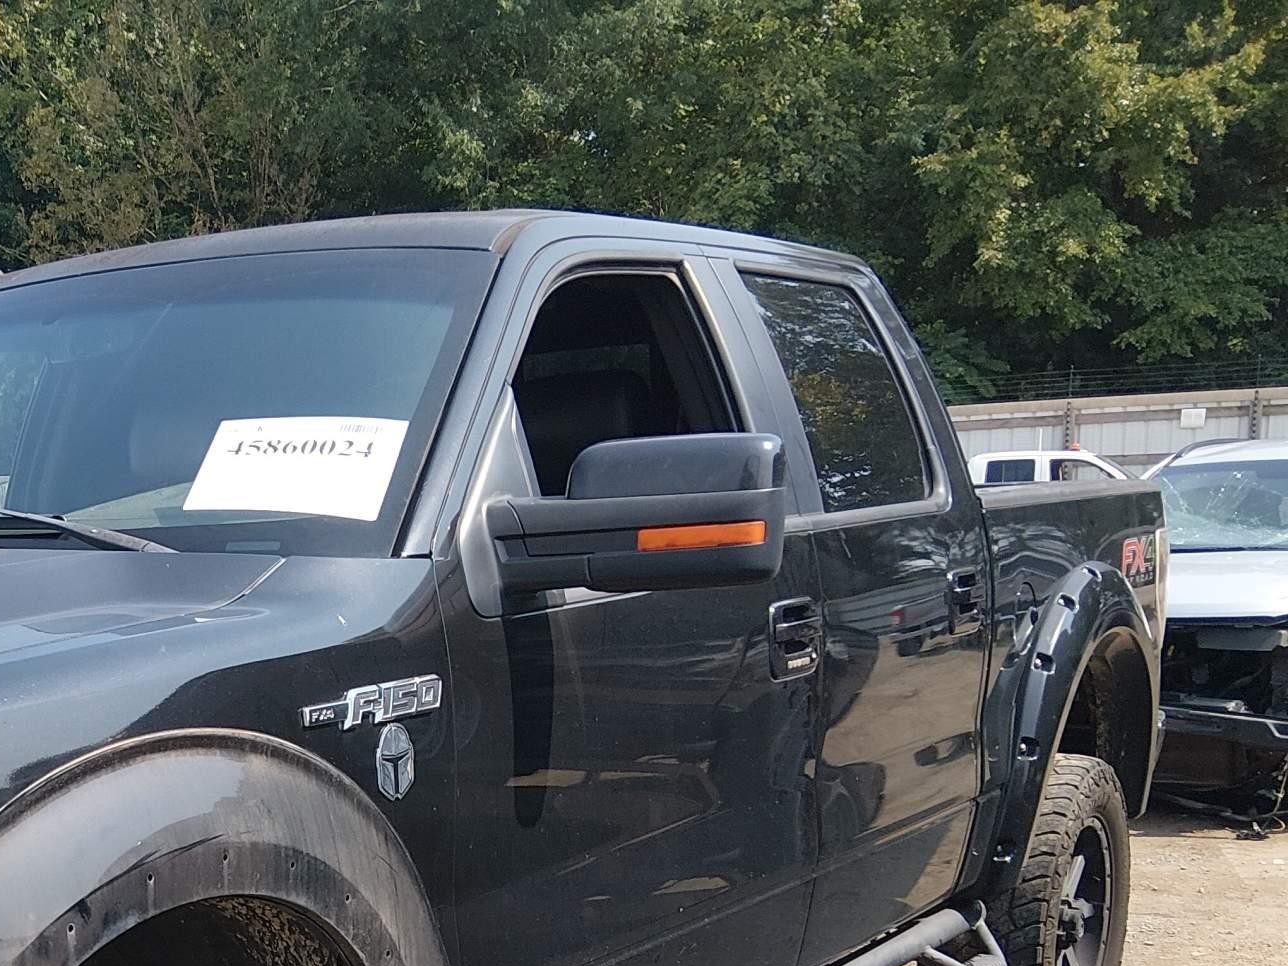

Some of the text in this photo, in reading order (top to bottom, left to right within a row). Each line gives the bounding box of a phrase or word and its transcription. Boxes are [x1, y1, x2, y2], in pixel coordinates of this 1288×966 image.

[227, 439, 373, 457] 45860024
[1121, 534, 1155, 576] FX4
[344, 674, 443, 730] F-150
